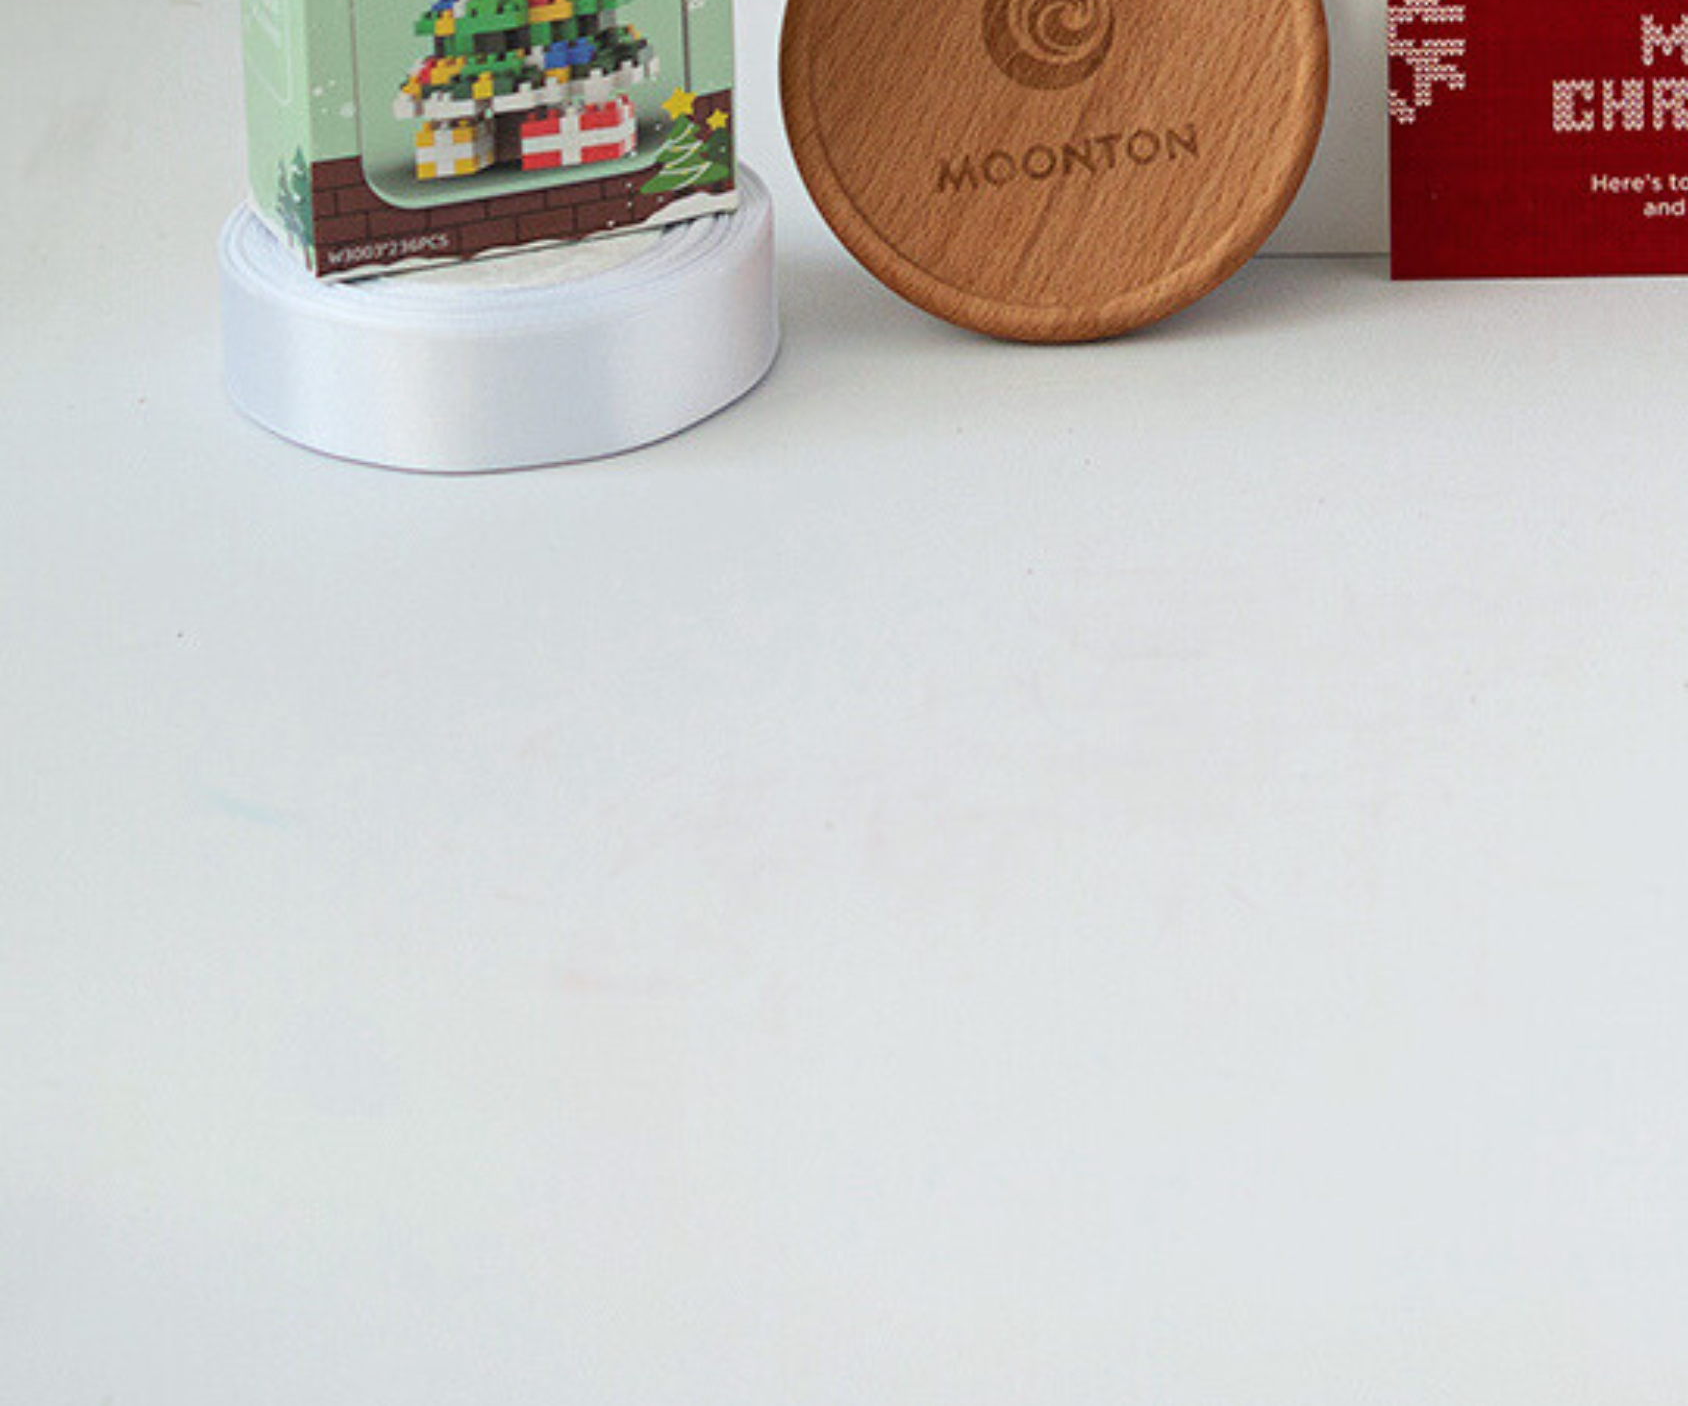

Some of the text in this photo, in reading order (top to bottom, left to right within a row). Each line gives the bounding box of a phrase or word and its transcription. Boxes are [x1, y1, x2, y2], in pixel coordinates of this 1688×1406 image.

[936, 122, 1200, 193] MOONTON
[1591, 173, 1664, 193] Here's
[1643, 197, 1686, 216] and
